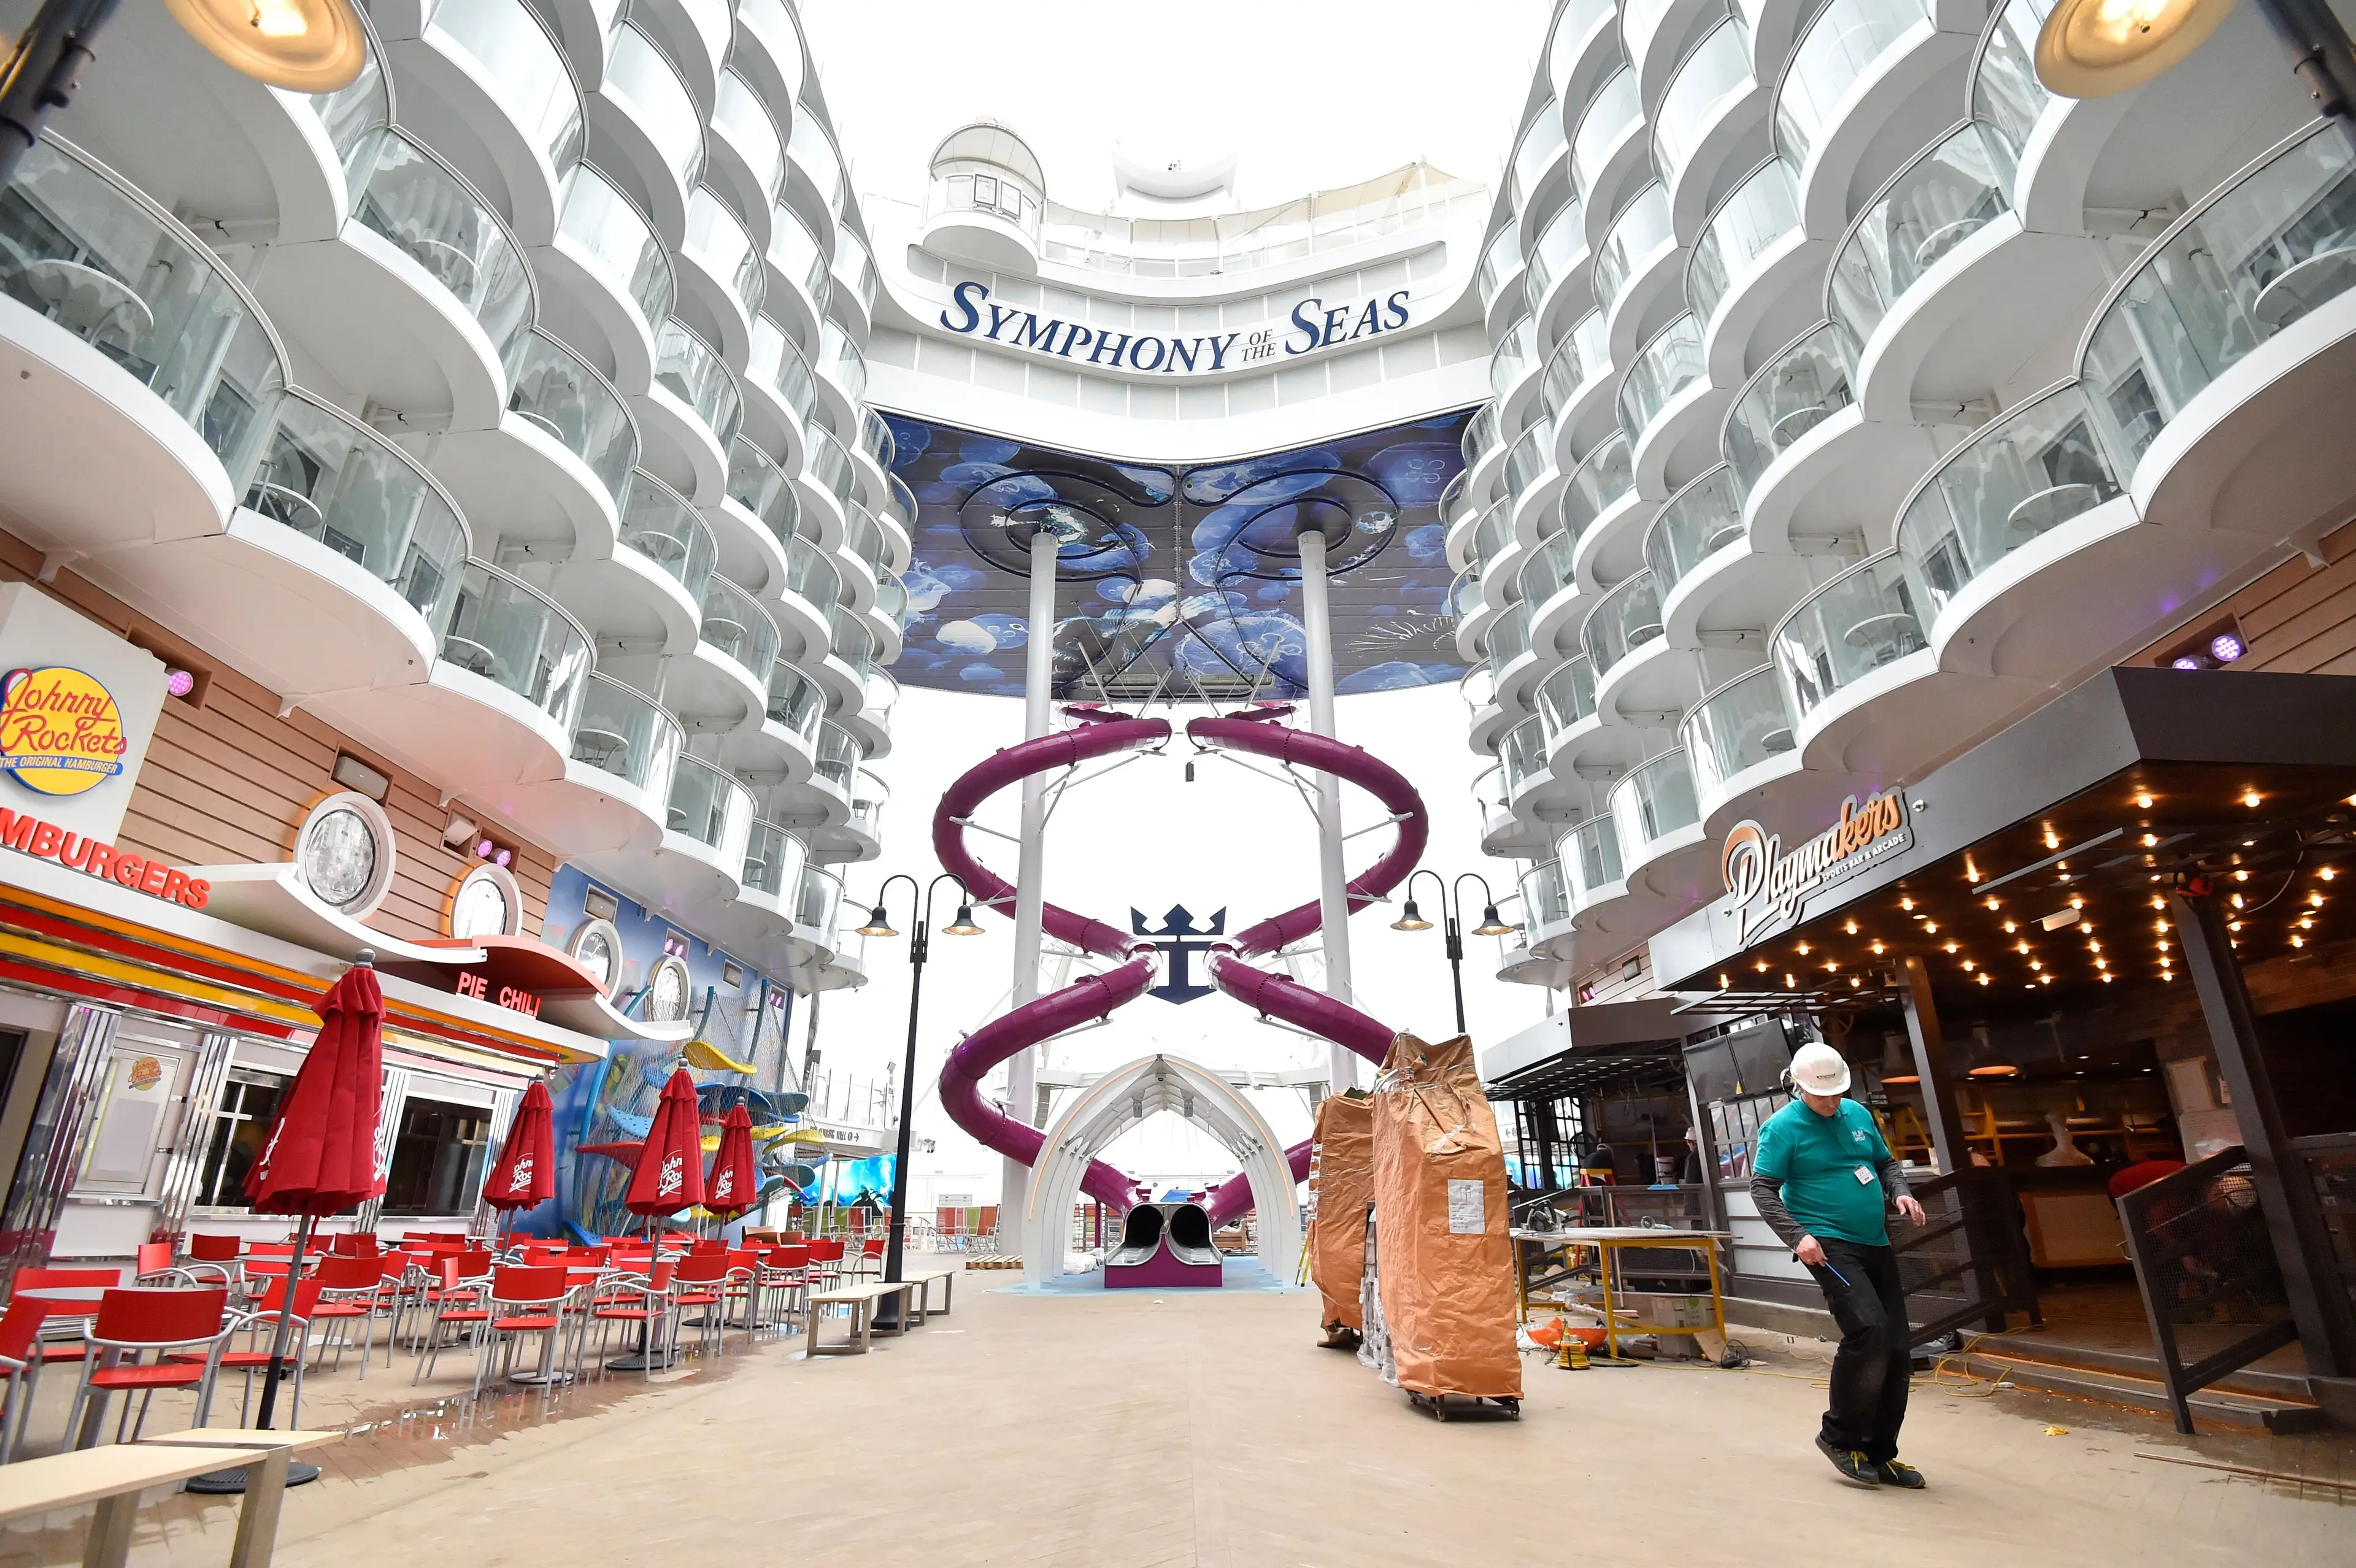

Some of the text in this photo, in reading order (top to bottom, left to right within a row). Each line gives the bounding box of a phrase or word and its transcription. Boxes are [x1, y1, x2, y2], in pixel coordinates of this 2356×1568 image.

[940, 281, 1409, 372] SYMPHONY OF THE SEAS
[0, 668, 116, 734] Johnny
[0, 715, 127, 755] Rockets
[0, 756, 118, 774] THE ORIGINAL HAMBURGER
[0, 807, 211, 909] MBURGERS
[1722, 794, 1902, 945] Playmakers
[1822, 833, 1905, 882] SPORTS BAR & ARCADE
[457, 971, 541, 1017] PIE CHILI
